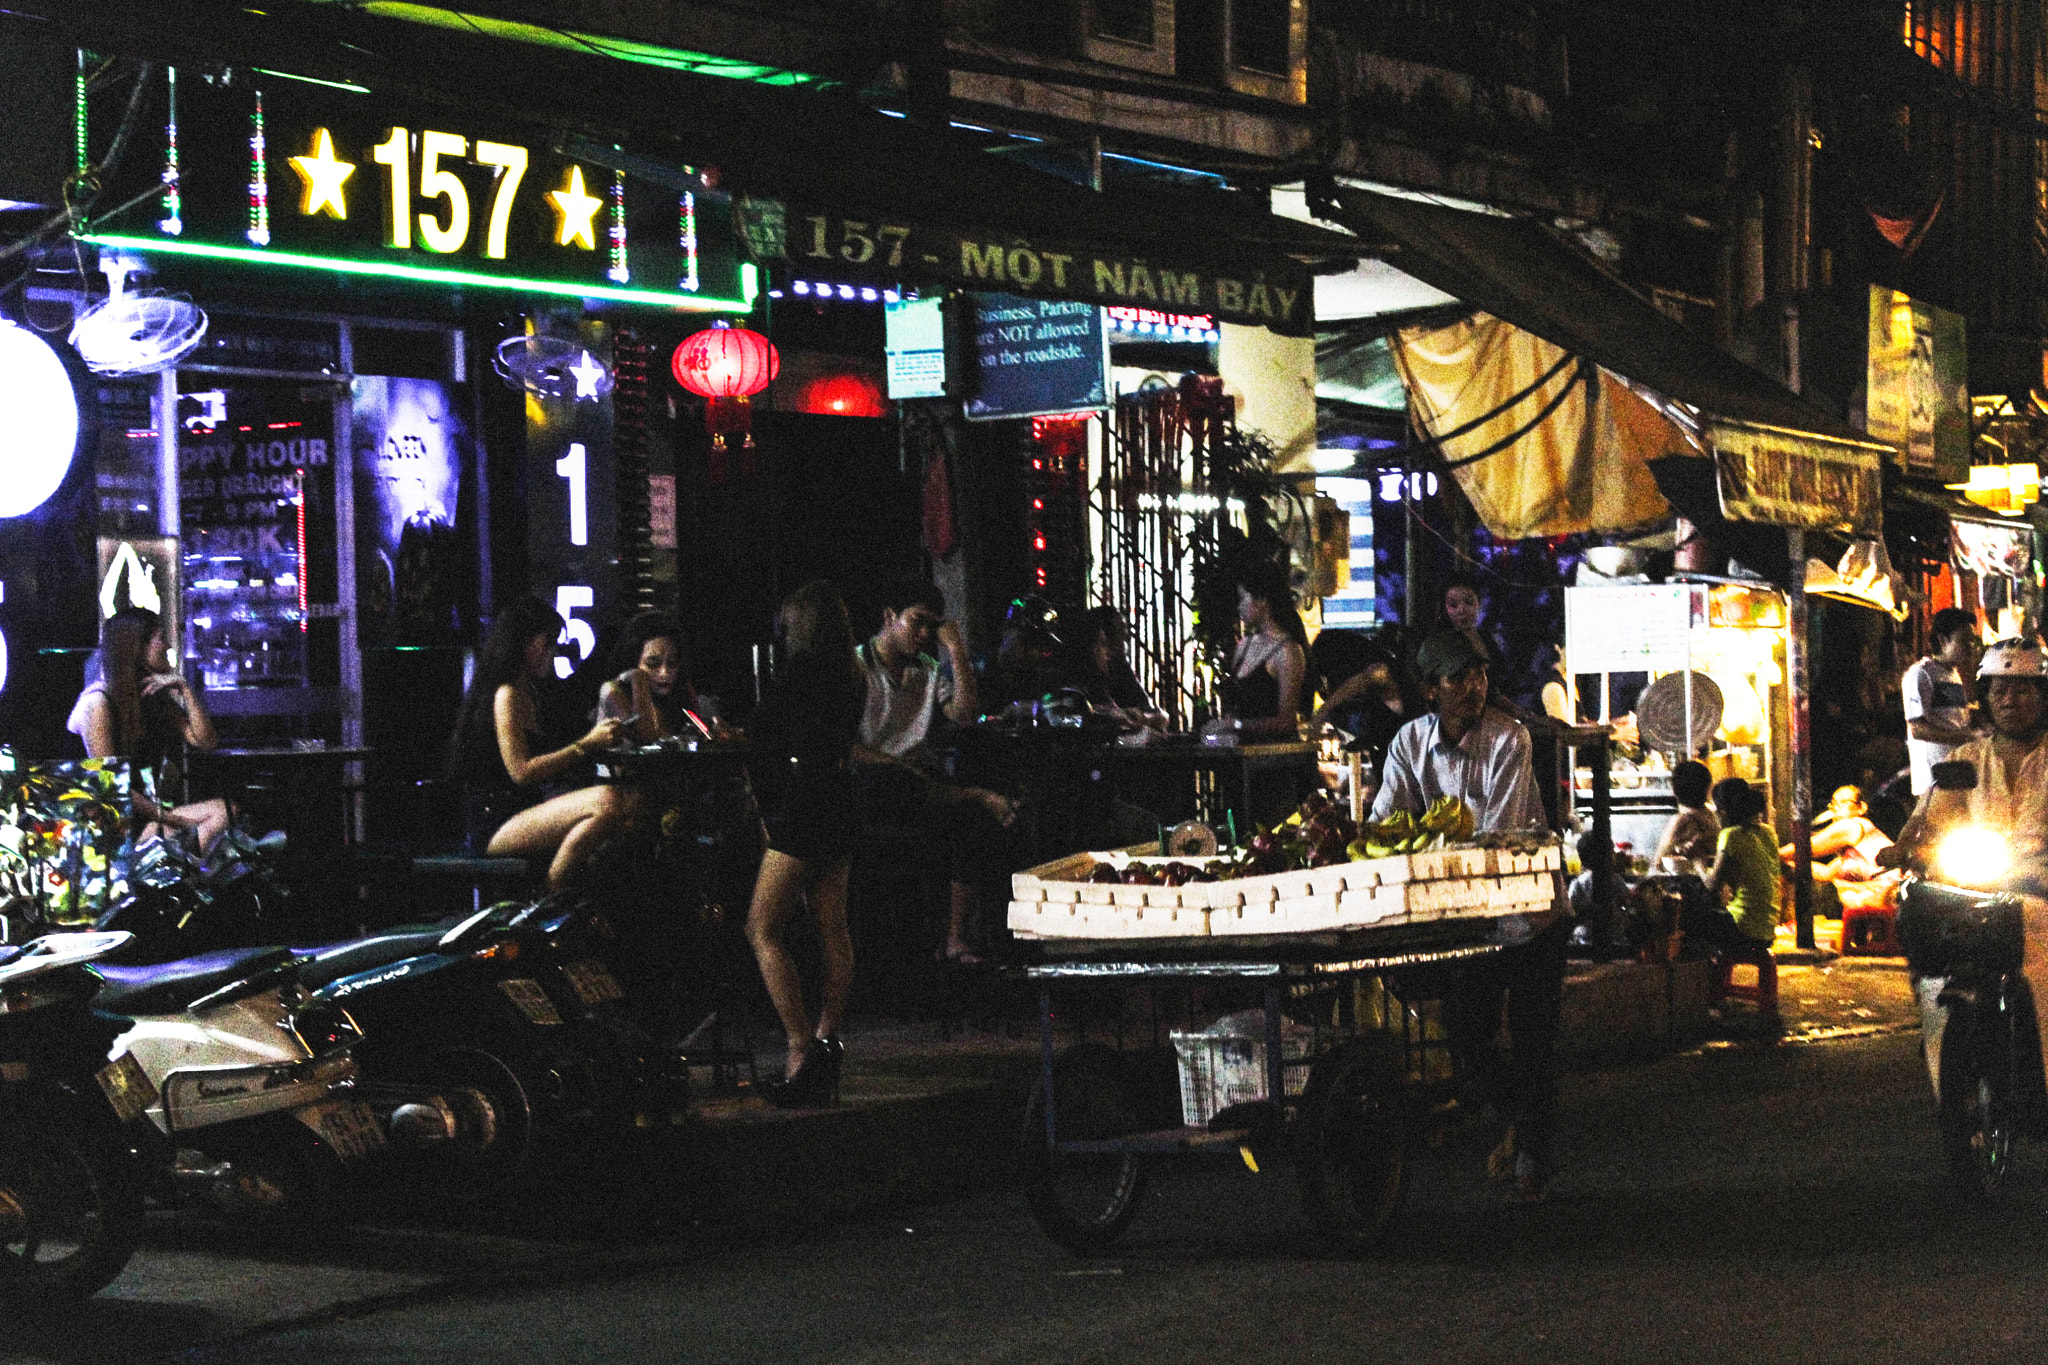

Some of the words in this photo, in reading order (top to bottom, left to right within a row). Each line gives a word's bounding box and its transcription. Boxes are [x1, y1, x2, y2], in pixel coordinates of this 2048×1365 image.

[373, 126, 529, 260] 157
[806, 215, 911, 267] 157
[960, 237, 1073, 291] MỘT
[1093, 256, 1201, 307] NĂM
[1040, 300, 1092, 317] Parking
[999, 325, 1032, 342] NOT
[1036, 318, 1090, 339] allowed
[1000, 348, 1021, 365] the
[1024, 342, 1085, 362] roadside.
[181, 444, 235, 472] PPY
[246, 438, 328, 468] HOUR
